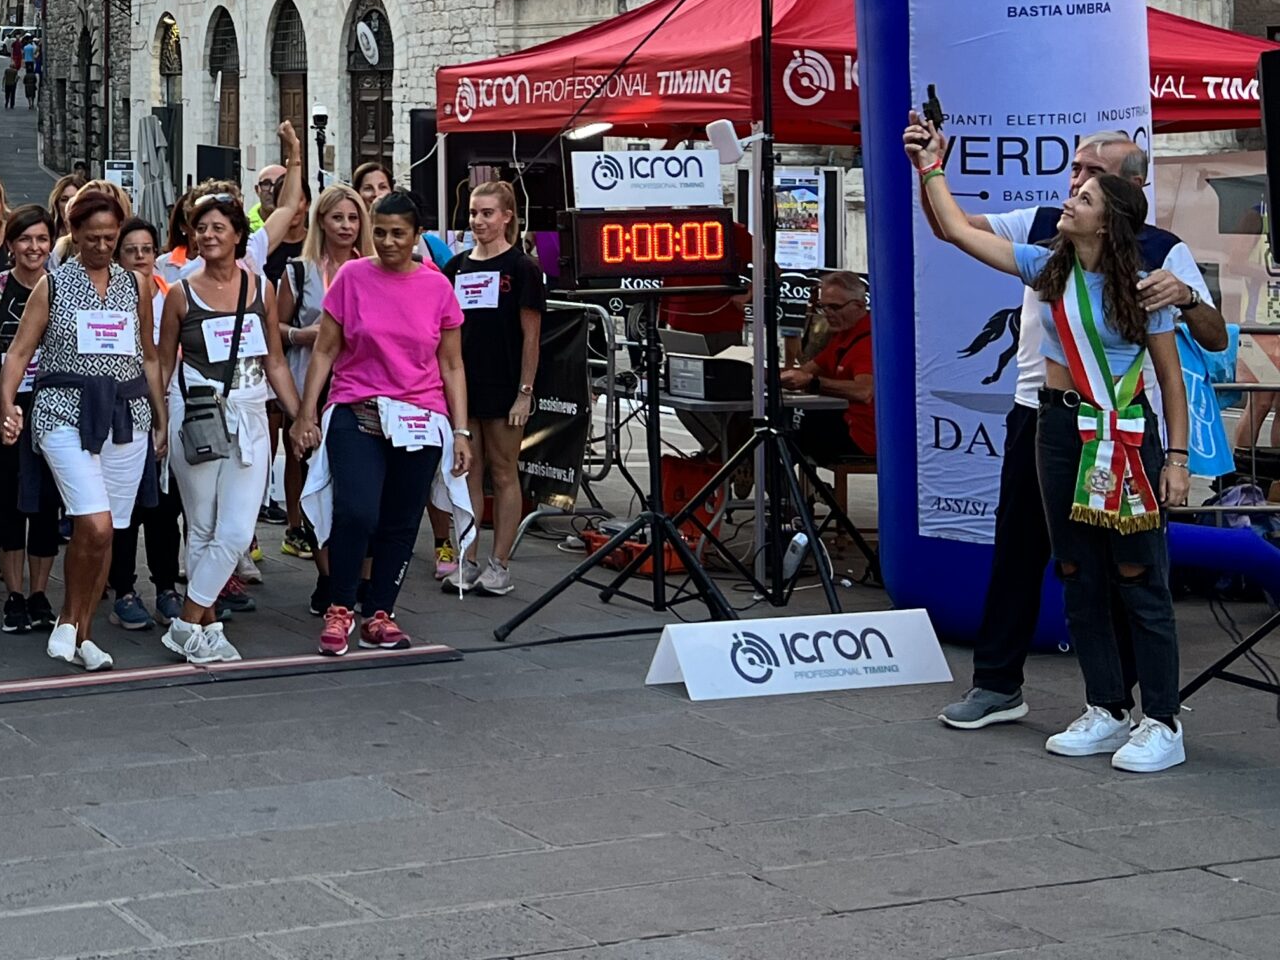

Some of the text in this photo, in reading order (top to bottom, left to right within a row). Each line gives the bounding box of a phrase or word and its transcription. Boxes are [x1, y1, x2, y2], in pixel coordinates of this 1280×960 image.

[1007, 2, 1112, 18] BASTIA UMBRA
[532, 73, 653, 104] PROFESSIONAL
[656, 68, 732, 97] TIMING
[1006, 112, 1087, 127] ELETTRICI
[1003, 190, 1060, 202] BASTIA
[602, 221, 724, 264] 0:00:00
[538, 396, 578, 415] assisinews
[931, 497, 989, 517] ASSISI
[794, 664, 900, 681] PROFESSIONAL TIMING
